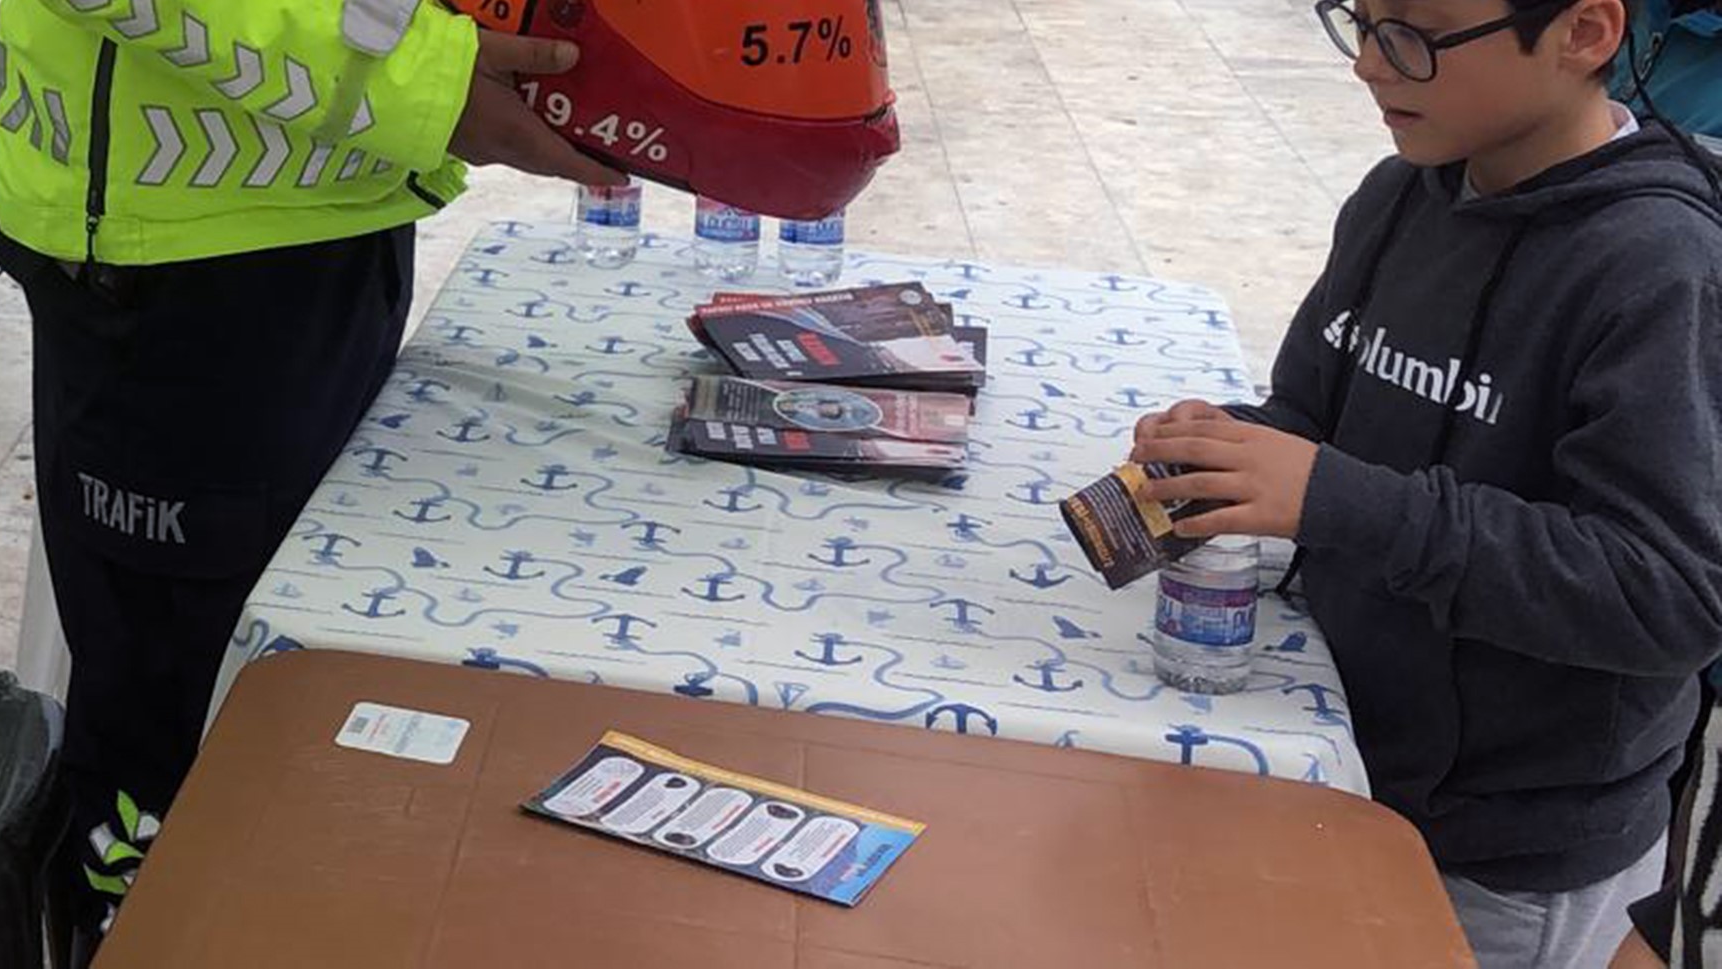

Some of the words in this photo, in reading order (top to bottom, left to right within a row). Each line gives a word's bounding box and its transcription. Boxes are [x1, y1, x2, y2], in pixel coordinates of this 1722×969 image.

[740, 15, 852, 67] 5.7%
[520, 81, 668, 162] 19.4%
[78, 471, 186, 544] TRAFİK
